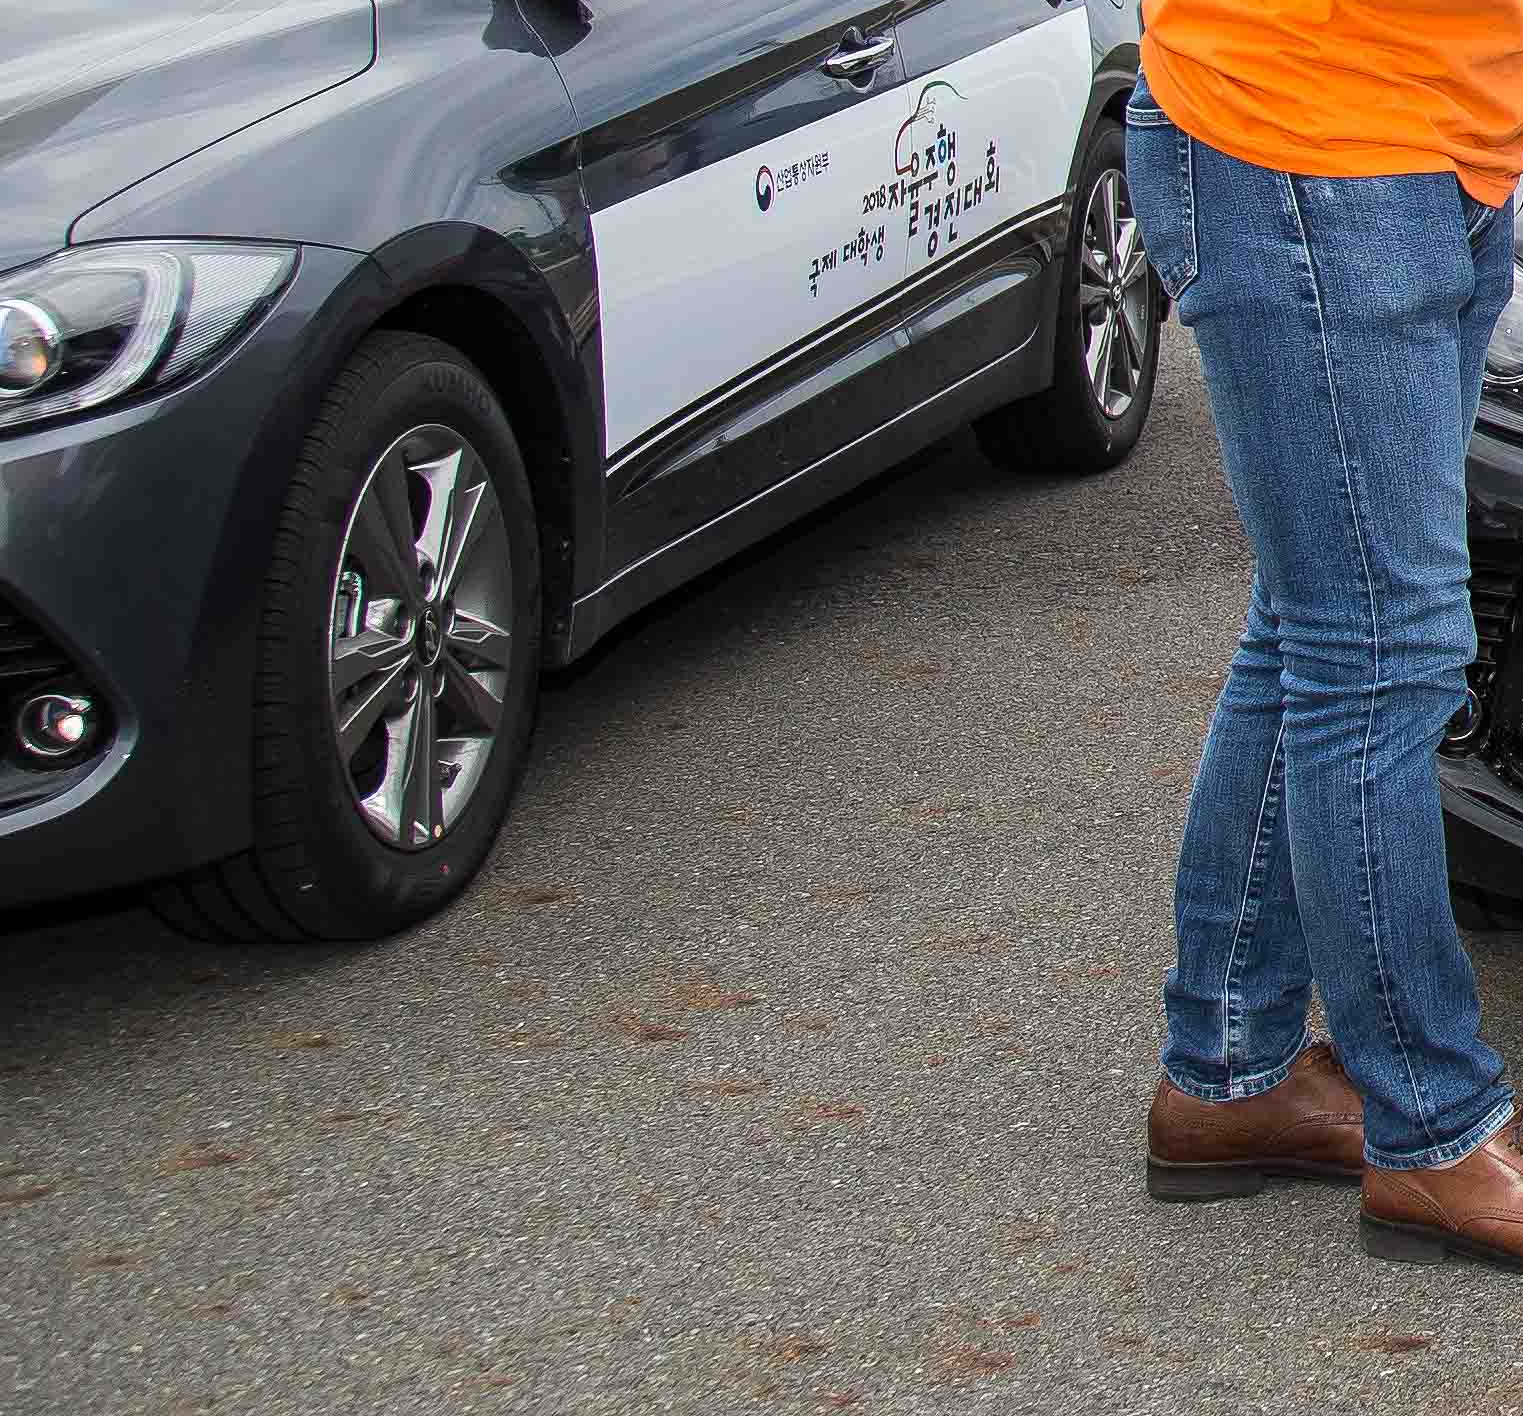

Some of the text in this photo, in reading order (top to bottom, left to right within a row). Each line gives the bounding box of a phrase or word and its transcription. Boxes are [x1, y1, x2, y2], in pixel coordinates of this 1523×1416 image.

[776, 151, 830, 193] 산업통상자원부
[808, 141, 1001, 298] 국제 대학생 경진대회
[863, 123, 956, 238] 2018 자율주행
